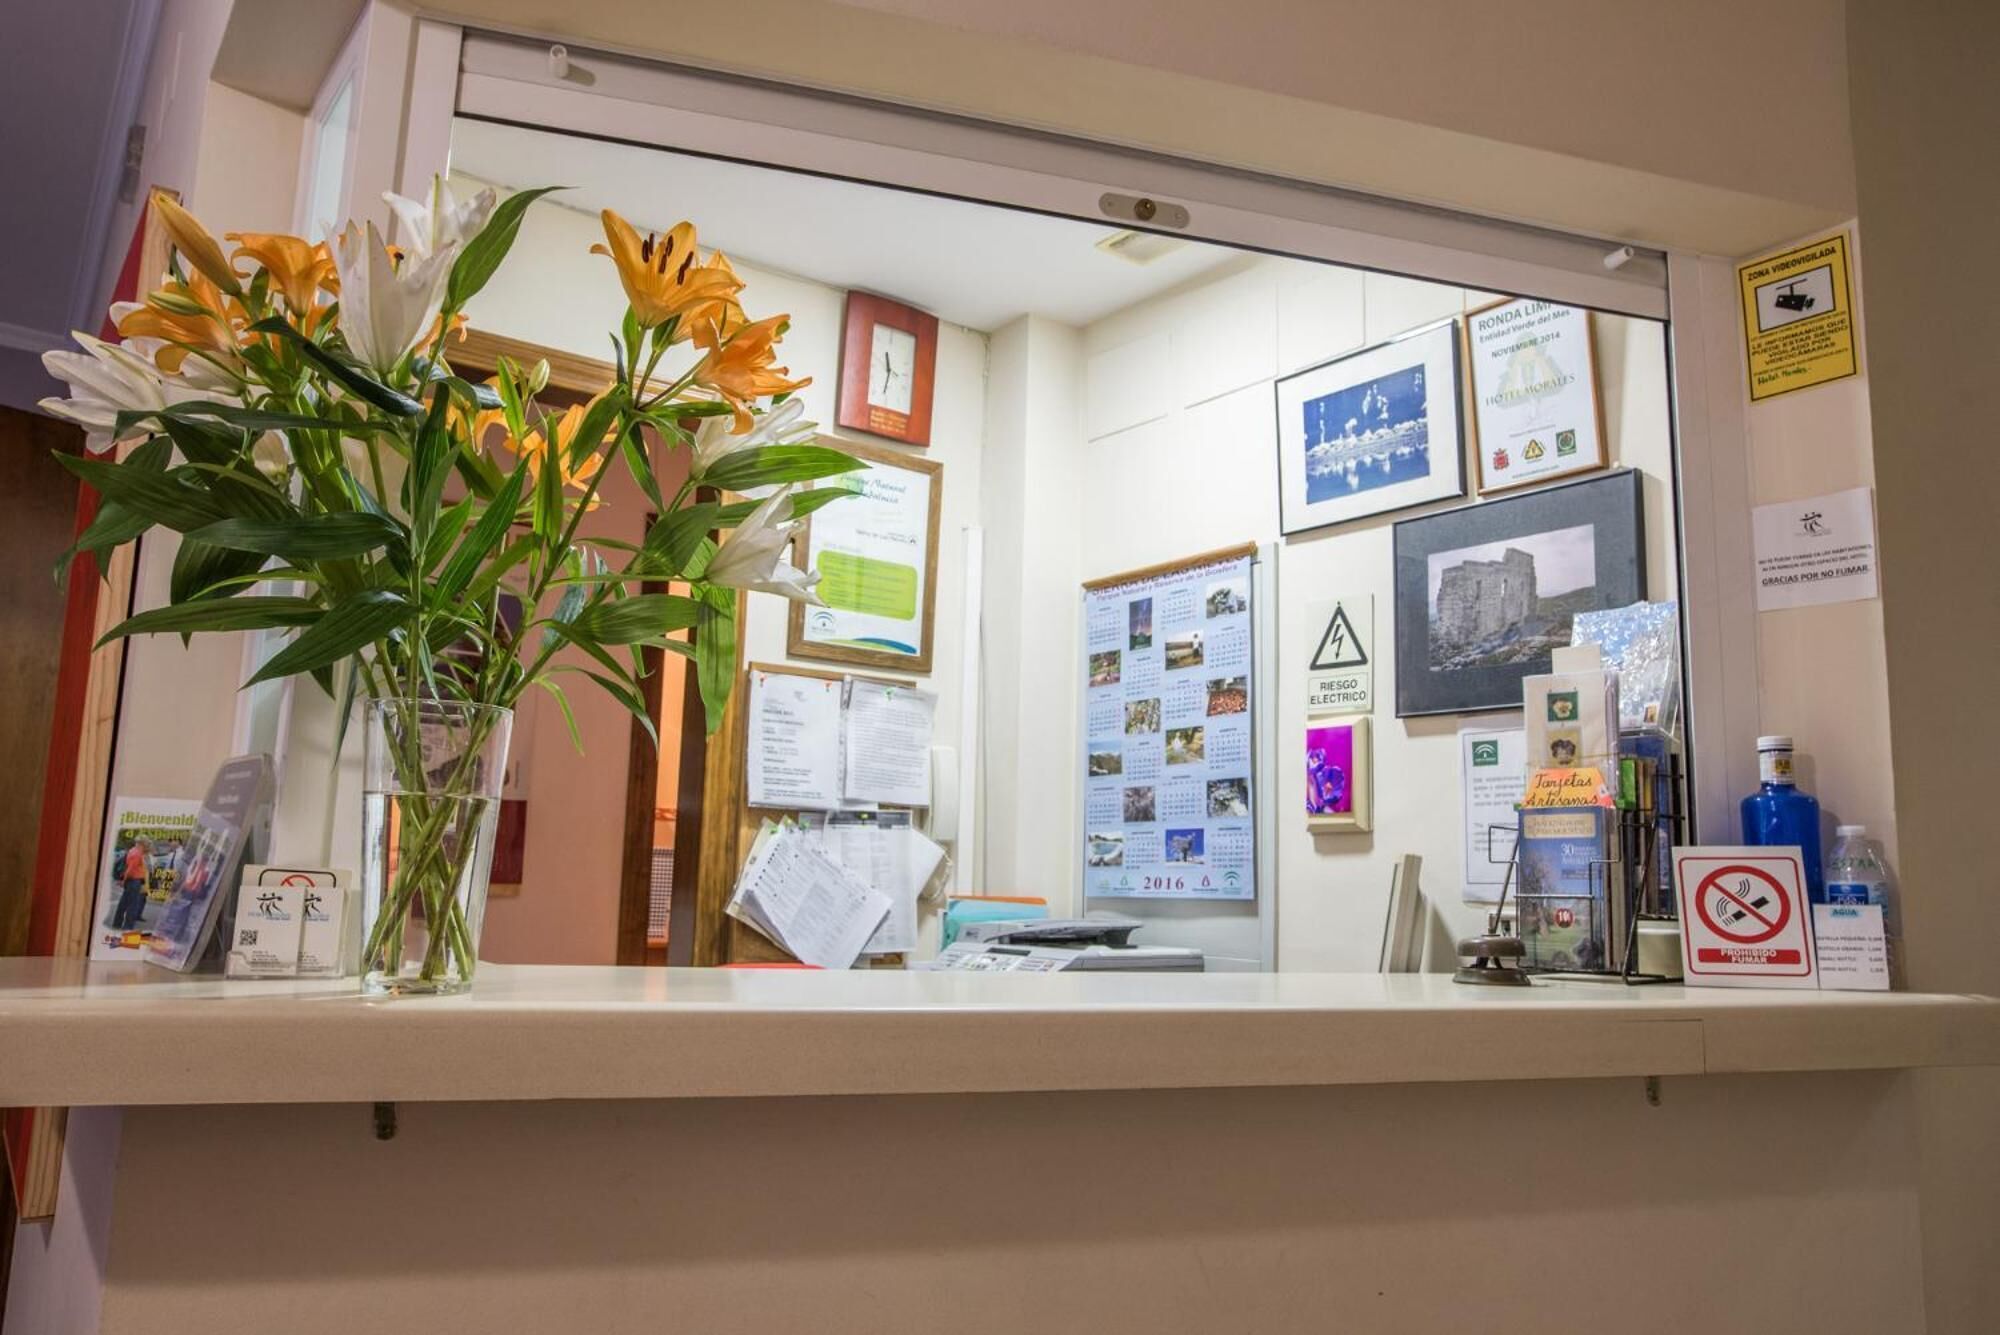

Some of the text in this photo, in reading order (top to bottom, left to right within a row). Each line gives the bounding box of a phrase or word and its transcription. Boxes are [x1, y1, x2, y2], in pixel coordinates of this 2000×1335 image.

[1748, 246, 1836, 281] ZONA VIDEOVIGILADA
[1478, 308, 1522, 331] RONDA
[1480, 309, 1570, 343] Entidad Verde del Mes
[1491, 331, 1560, 358] NOVIEMBRE 2014
[1523, 374, 1575, 396] MORALES
[1762, 574, 1799, 586] GRACIAS
[1800, 572, 1819, 581] POR
[1820, 569, 1834, 578] NO
[1320, 679, 1358, 691] RIESGO
[1535, 772, 1592, 796] Tarjetas
[120, 811, 197, 826] ¡Bienvenid
[1143, 876, 1185, 891] 2016
[1832, 908, 1858, 916] AGUA
[1720, 948, 1777, 958] PROHIBIDO
[1731, 955, 1768, 964] FUMAR
